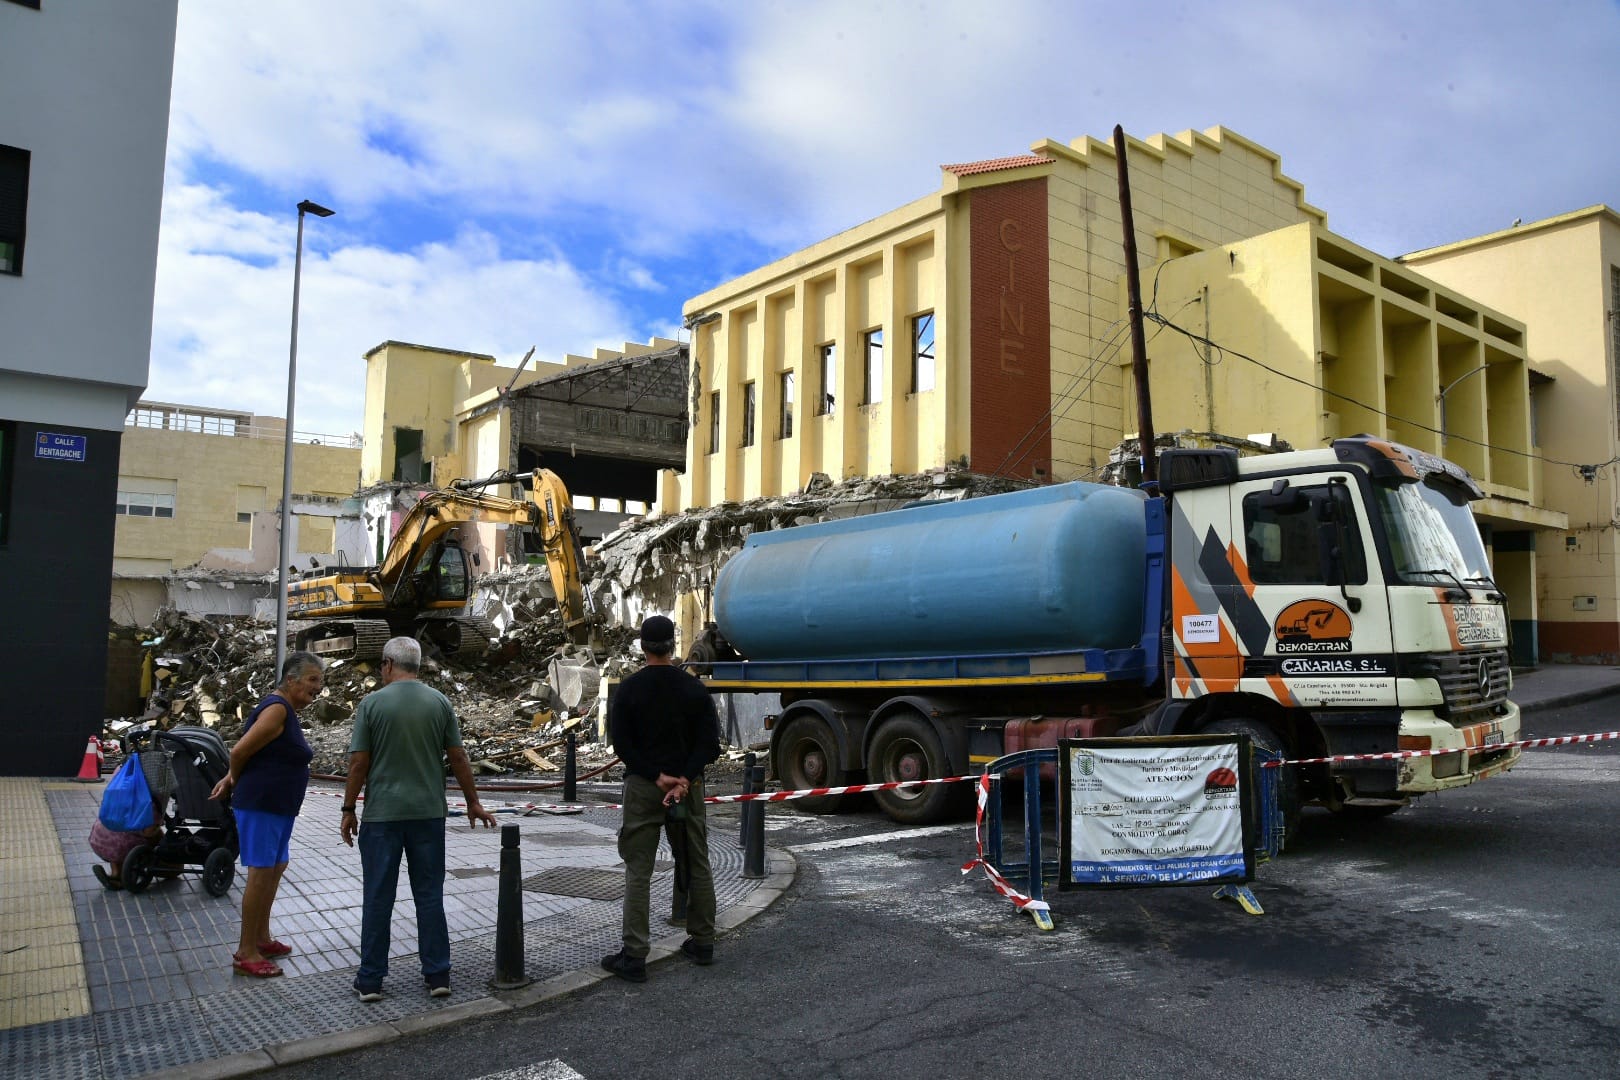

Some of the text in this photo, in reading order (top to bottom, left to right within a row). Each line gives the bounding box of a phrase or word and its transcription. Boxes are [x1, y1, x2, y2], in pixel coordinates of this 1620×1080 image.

[1000, 218, 1025, 376] CINE
[54, 438, 76, 446] CALLE
[38, 446, 82, 458] BENTAGACHE
[1278, 642, 1349, 652] DEMOEXTRAN
[1360, 660, 1387, 671] S.L.
[1115, 874, 1156, 882] SERVICIO
[1159, 873, 1170, 881] DE
